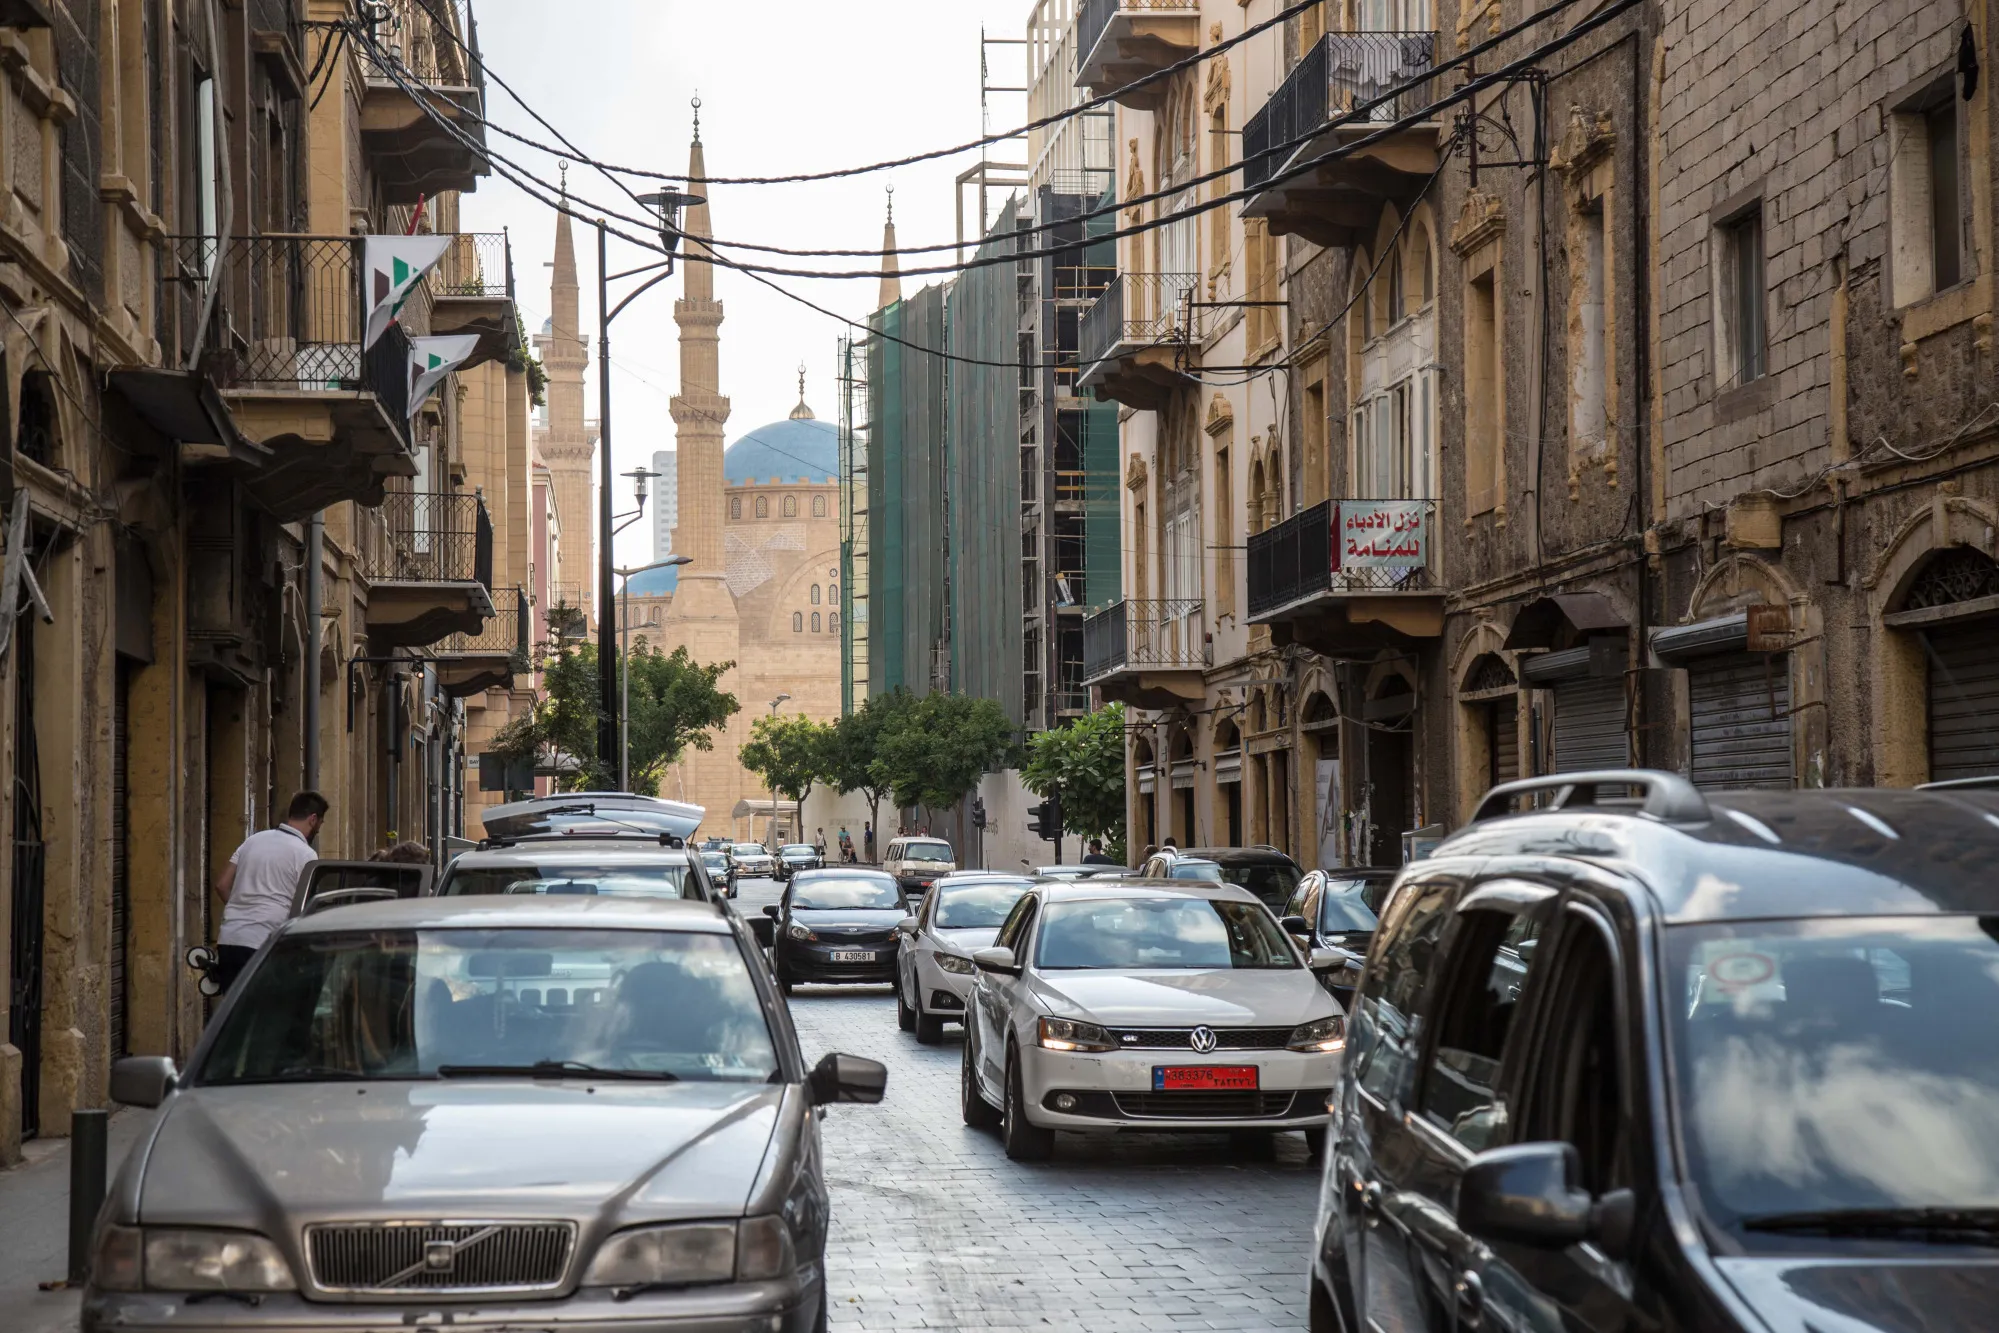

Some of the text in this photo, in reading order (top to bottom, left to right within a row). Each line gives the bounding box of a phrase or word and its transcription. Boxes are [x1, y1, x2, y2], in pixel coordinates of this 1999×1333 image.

[1346, 508, 1420, 533] نزل الأدباء
[1346, 537, 1420, 558] للمنامة
[845, 952, 870, 960] 430581
